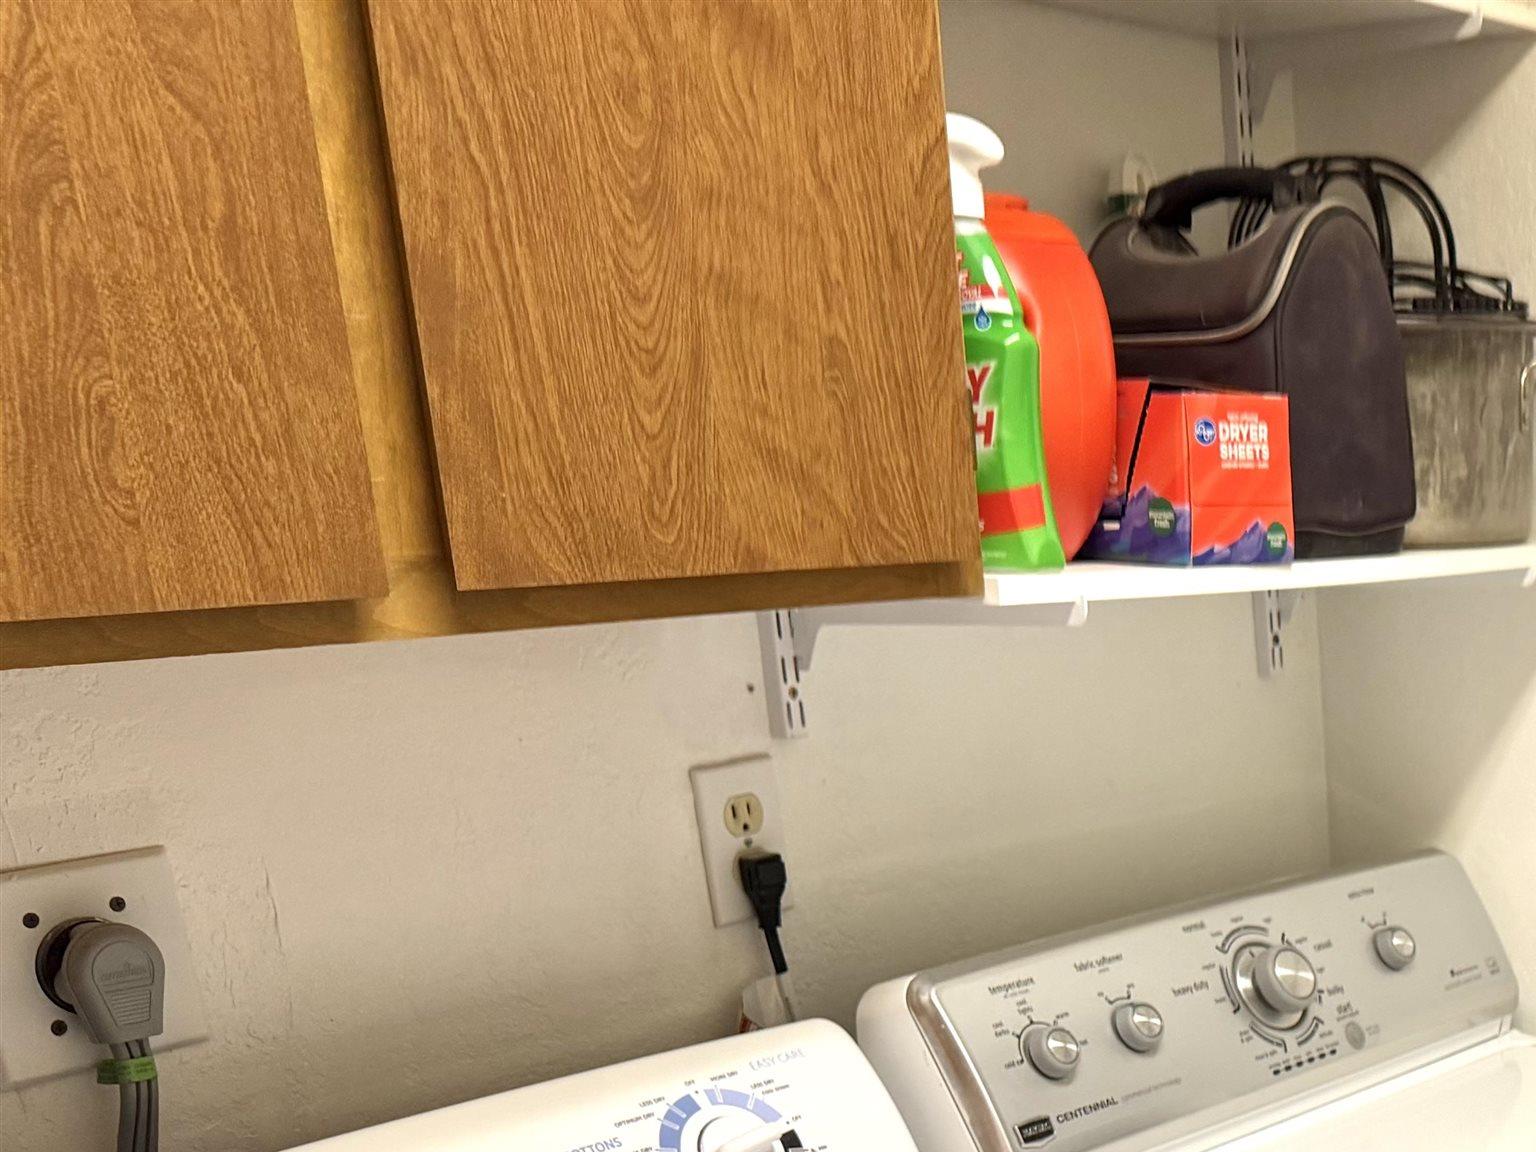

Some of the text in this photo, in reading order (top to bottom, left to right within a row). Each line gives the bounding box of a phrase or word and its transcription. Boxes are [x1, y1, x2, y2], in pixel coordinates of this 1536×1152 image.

[1218, 422, 1268, 443] DRYER
[1219, 443, 1270, 461] SHEETS
[988, 977, 1036, 996] temperature
[1056, 1096, 1119, 1124] CENTENNIAL
